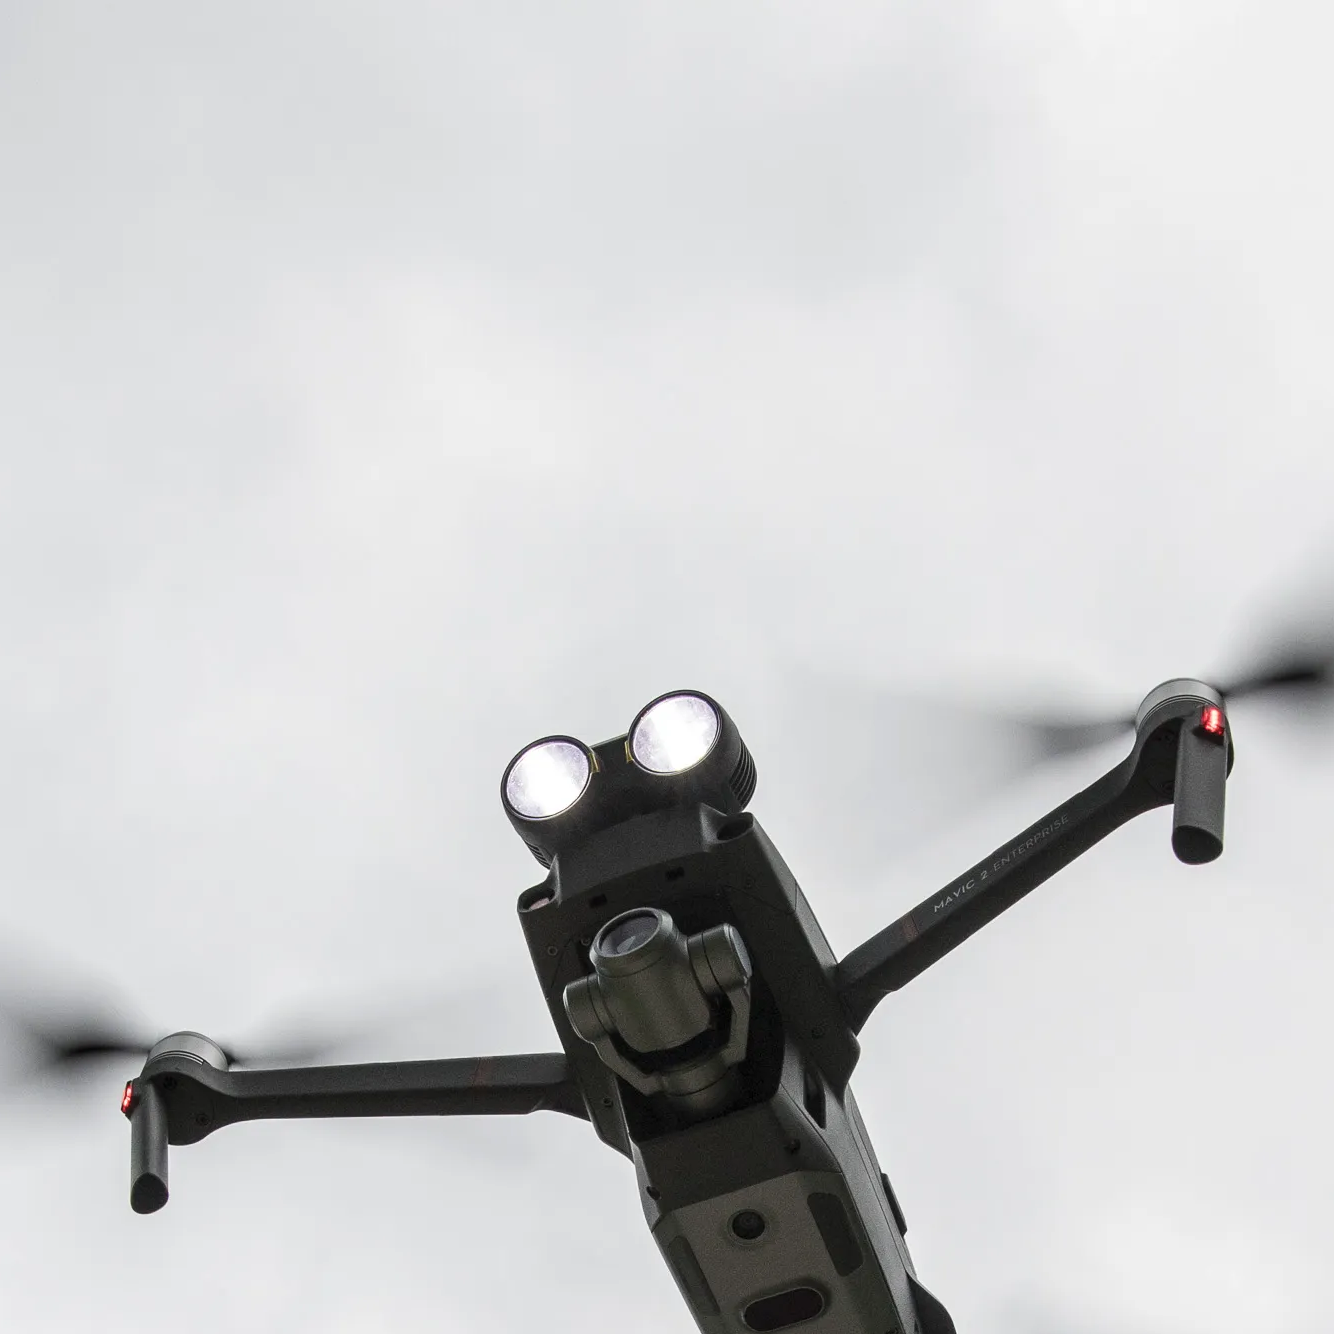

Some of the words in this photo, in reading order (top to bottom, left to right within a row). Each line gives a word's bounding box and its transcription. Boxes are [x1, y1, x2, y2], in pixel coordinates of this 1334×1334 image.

[934, 879, 976, 913] MAVIC
[980, 870, 988, 880] 2
[993, 814, 1069, 872] ENTERPRISE
